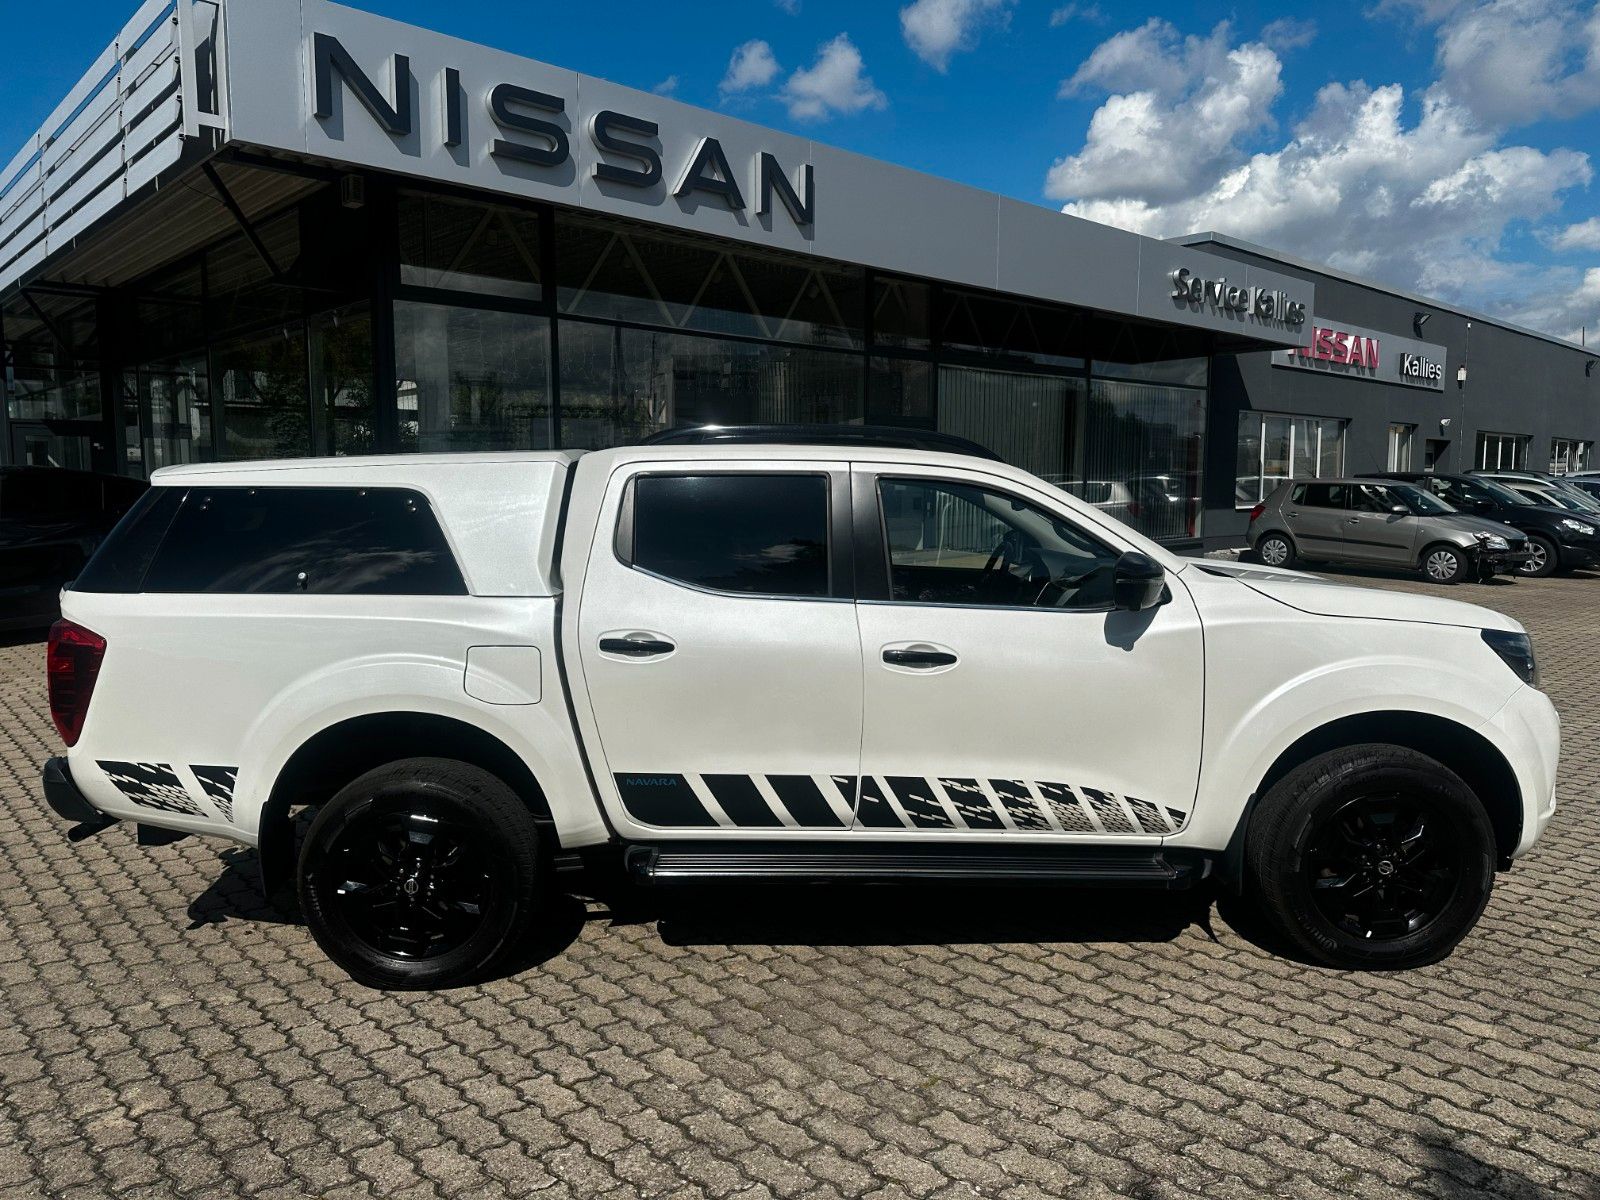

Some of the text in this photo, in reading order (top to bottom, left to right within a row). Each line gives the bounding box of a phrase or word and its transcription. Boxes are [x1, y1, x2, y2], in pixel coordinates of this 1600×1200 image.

[310, 31, 815, 226] NISSAN
[1171, 267, 1305, 325] Service Kallies
[1403, 353, 1442, 380] Kallies
[626, 778, 677, 787] NAVARA
